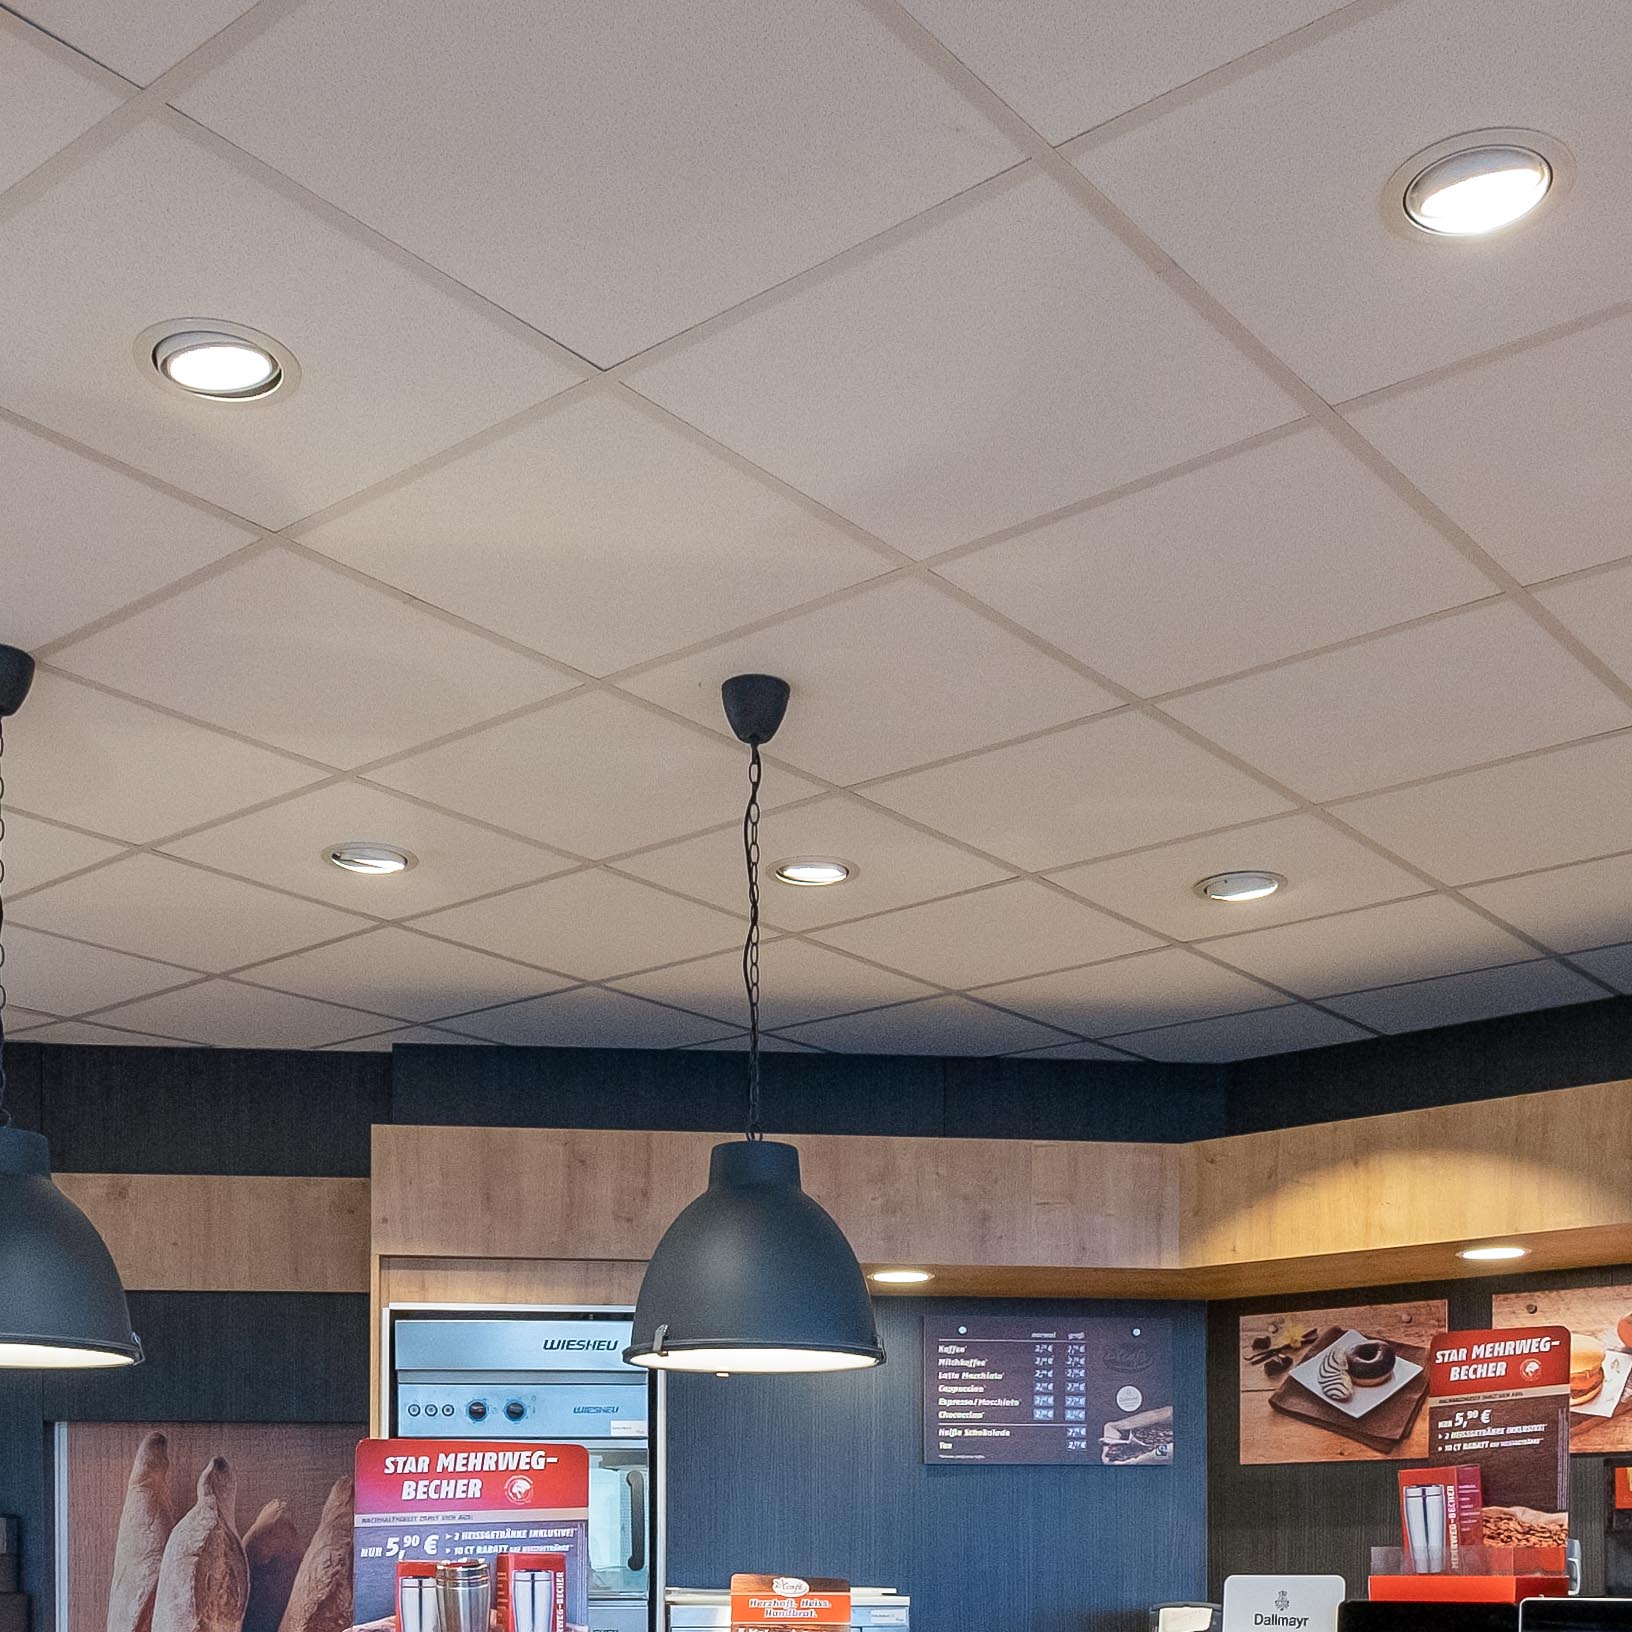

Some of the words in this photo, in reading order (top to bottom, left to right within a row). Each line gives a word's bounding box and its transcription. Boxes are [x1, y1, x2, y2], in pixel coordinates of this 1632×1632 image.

[543, 1339, 619, 1351] WIESHEU
[1435, 1348, 1468, 1364] STAR
[1471, 1337, 1561, 1360] MEHRWEG-
[1449, 1361, 1508, 1382] BECHER
[573, 1406, 619, 1415] WIESHEU
[1480, 1409, 1492, 1424] €
[938, 1442, 953, 1450] Tee
[384, 1456, 430, 1474] STAR
[436, 1451, 559, 1473] MEHRWEG-
[402, 1478, 483, 1500] BECHER
[462, 1528, 528, 1541] HEISSGETRÄNKE
[361, 1547, 383, 1558] NUR
[424, 1534, 440, 1555] €
[477, 1545, 508, 1555] RABATT
[1254, 1612, 1309, 1630] Dallmayr
